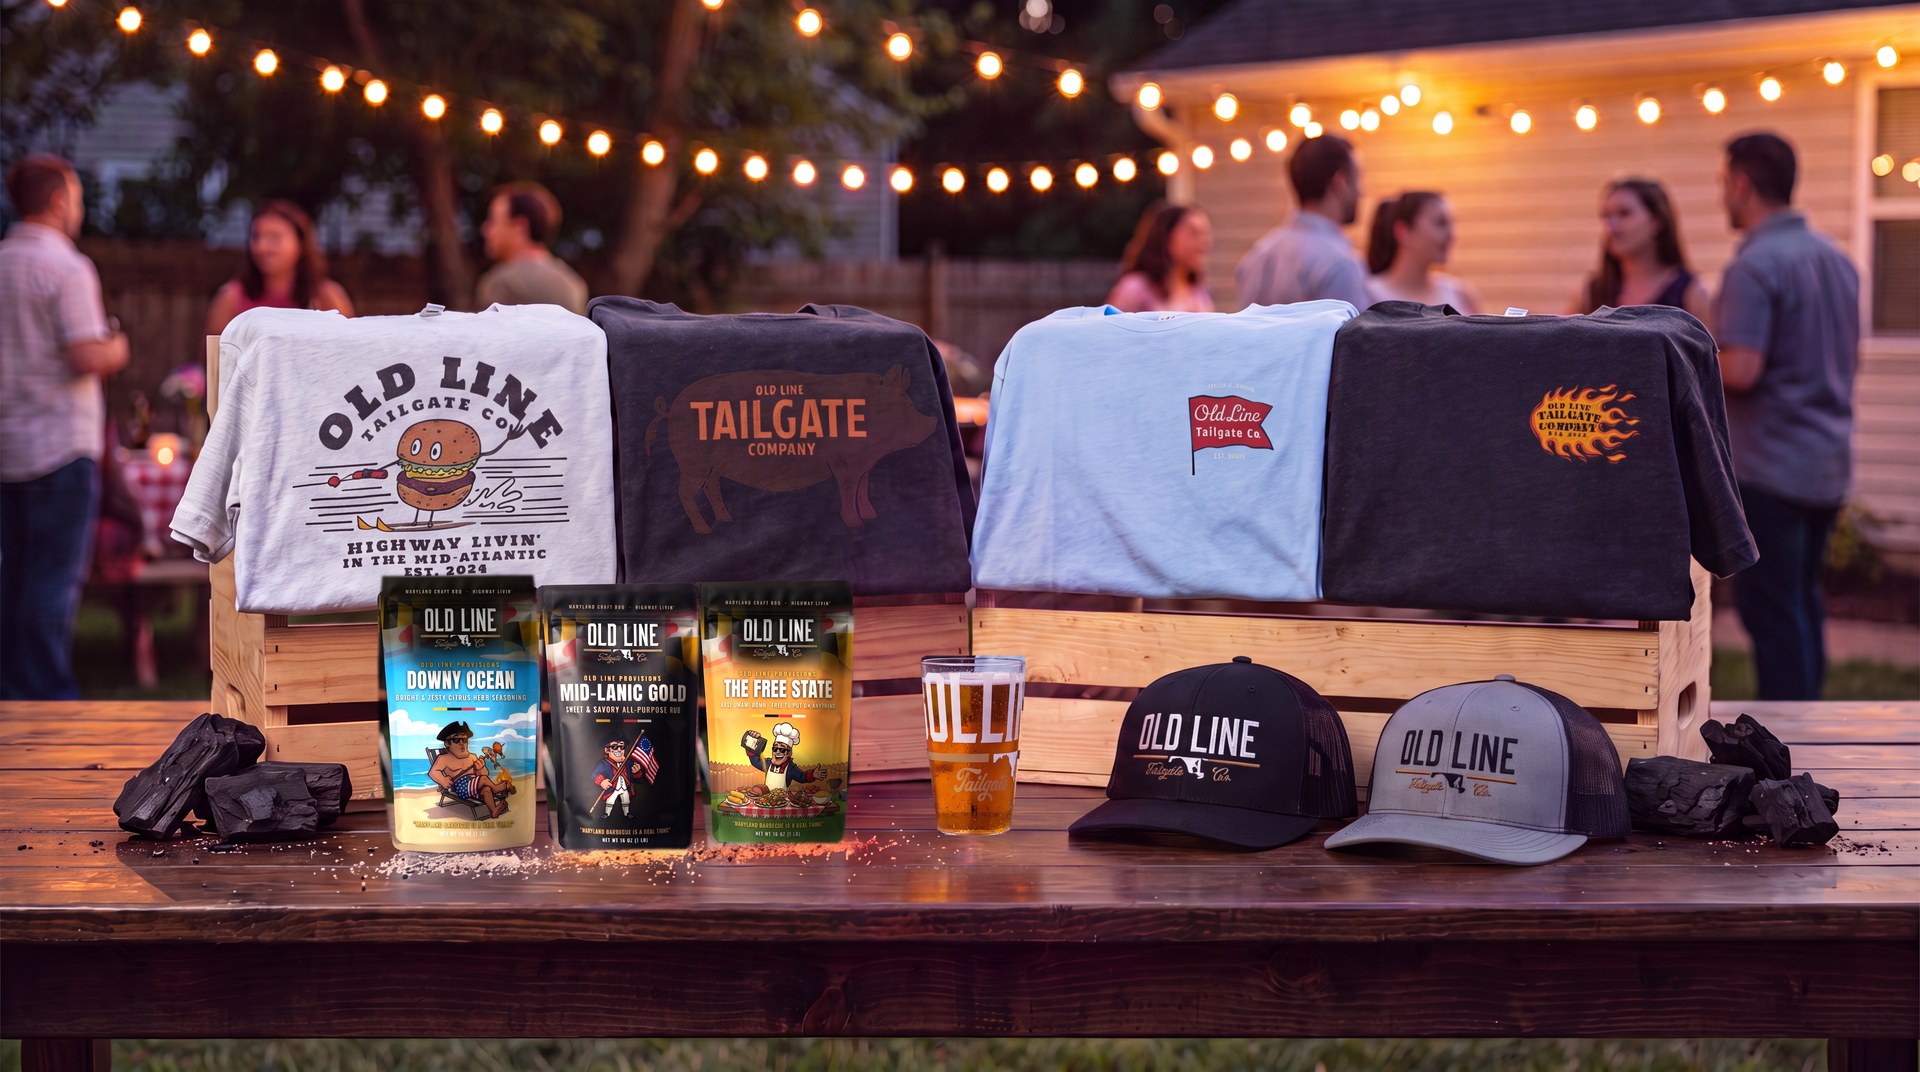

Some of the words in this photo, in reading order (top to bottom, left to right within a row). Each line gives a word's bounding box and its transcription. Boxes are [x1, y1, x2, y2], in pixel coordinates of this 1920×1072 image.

[755, 384, 777, 396] OLD
[780, 384, 804, 395] LINE
[318, 361, 416, 451] OLD
[440, 356, 564, 450] LINE
[1194, 404, 1226, 422] Old
[1226, 404, 1261, 422] Line
[1569, 403, 1592, 412] LINE
[361, 396, 471, 442] TAILGATE
[481, 407, 508, 429] CO
[690, 398, 868, 441] TAILGATE
[1537, 410, 1602, 424] TAILGATE
[1196, 427, 1243, 440] Tailgate
[1247, 428, 1261, 439] Co.
[748, 442, 816, 456] COMPANY
[347, 536, 461, 555] HIGHWAY
[472, 533, 542, 549] LIVIN'
[342, 557, 363, 568] IN
[371, 554, 406, 567] THE
[414, 549, 547, 564] MID-ATLANTIC
[403, 566, 440, 577] EST.
[445, 563, 488, 576] 2024
[424, 607, 454, 632] OLD
[461, 607, 497, 632] LINE
[587, 623, 617, 647] OLD
[623, 623, 659, 647] LINE
[743, 618, 772, 642] OLD
[779, 618, 814, 642] LINE
[407, 670, 461, 690] DOWNY
[466, 670, 515, 690] OCEAN
[723, 679, 749, 698] THE
[753, 679, 787, 698] FREE
[791, 679, 833, 699] STATE
[560, 683, 643, 702] MID-LANIC
[648, 684, 687, 702] GOLD
[566, 706, 584, 714] SWEET
[585, 706, 591, 714] &
[593, 706, 619, 714] SAVORY
[622, 706, 667, 714] ALL-PURPOSE
[669, 706, 681, 714] RUB
[1138, 713, 1183, 751] OLD
[1190, 715, 1260, 759] LINE
[1400, 729, 1444, 767] OLD
[1451, 731, 1519, 775] LINE
